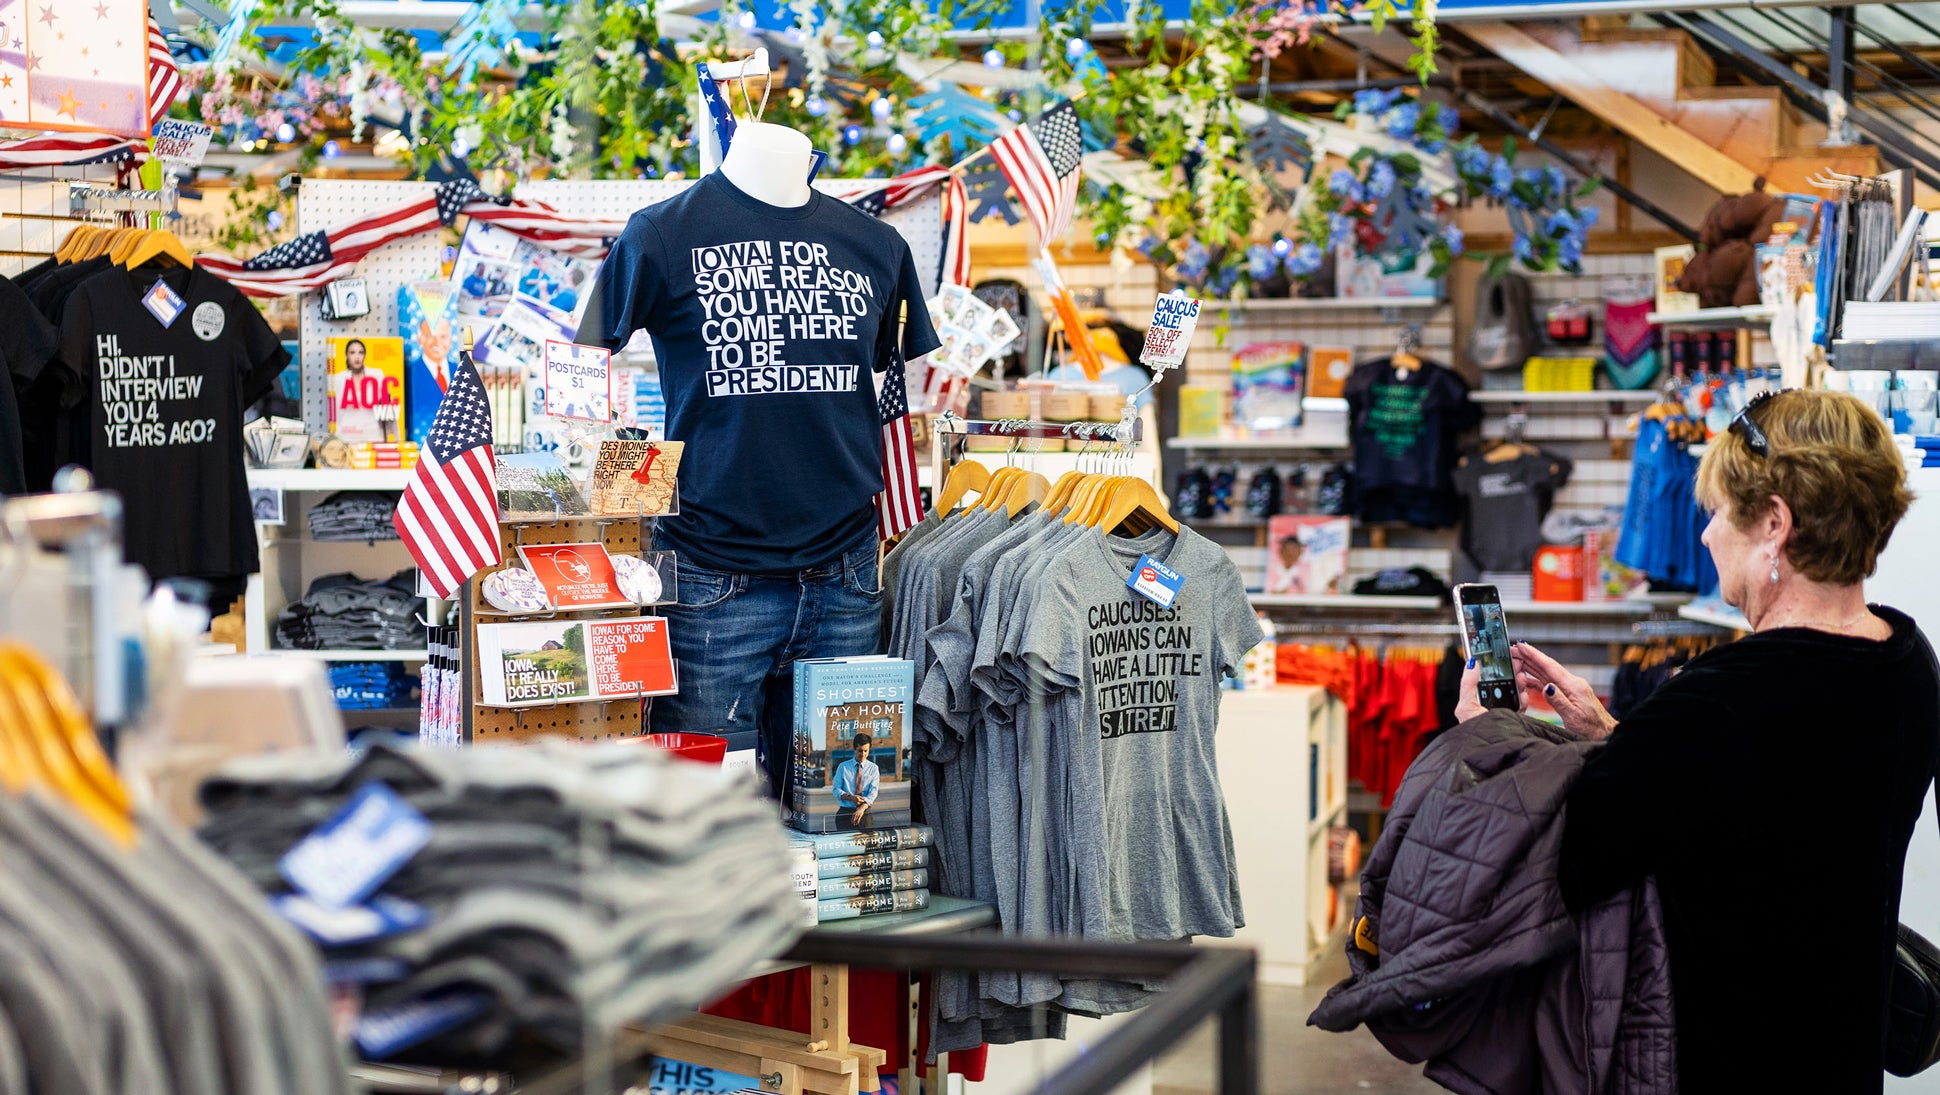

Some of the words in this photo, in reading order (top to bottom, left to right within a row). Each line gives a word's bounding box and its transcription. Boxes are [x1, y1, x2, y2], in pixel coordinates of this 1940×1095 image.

[162, 121, 211, 136] CAUCUS
[692, 240, 774, 274] IOWA!
[779, 241, 830, 267] FOR
[695, 265, 776, 295] SOME
[779, 265, 874, 298] REASON
[698, 291, 758, 320] YOU
[764, 290, 833, 314] HAVE
[835, 291, 868, 317] TO
[1157, 298, 1198, 317] CAUCUS
[1152, 312, 1182, 330] SALE!
[701, 315, 785, 345] COME
[789, 315, 858, 340] HERE
[1148, 326, 1166, 339] 50%
[1166, 329, 1183, 340] OFF
[96, 334, 122, 358] HI,
[1143, 345, 1168, 354] ITEMS!
[1145, 336, 1175, 349] SELECT
[706, 343, 744, 371] TO
[750, 340, 786, 367] BE
[98, 355, 165, 380] DIDN'T
[168, 354, 175, 378] I
[548, 361, 607, 379] POSTCARDS
[100, 375, 203, 402] INTERVIEW
[706, 365, 859, 397] PRESIDENT!
[340, 376, 400, 411] AOC
[103, 401, 144, 425] YOU
[145, 400, 160, 423] 4
[373, 404, 402, 422] WAY
[104, 422, 167, 448] YEARS
[168, 418, 217, 446] AGO?
[601, 441, 619, 451] DES
[620, 441, 657, 451] MOINES:
[599, 450, 616, 461] YOU
[617, 451, 647, 461] MIGHT
[596, 460, 606, 470] BE
[609, 460, 638, 470] THERE
[593, 470, 621, 480] RIGHT
[593, 480, 614, 490] NOW.
[1146, 557, 1180, 582] RAYGUN
[1088, 601, 1181, 630] CAUCUSES:
[592, 626, 615, 636] IOWA!
[616, 625, 632, 635] FOR
[633, 623, 656, 633] SOME
[593, 635, 628, 645] REASON,
[628, 634, 645, 643] YOU
[1089, 627, 1150, 659] IOWANS
[1154, 626, 1192, 650] CAN
[594, 645, 615, 655] HAVE
[615, 644, 627, 654] TO
[504, 659, 537, 673] IOWA:
[594, 654, 619, 665] COME
[596, 664, 619, 674] HERE
[1091, 656, 1128, 686] HAVE
[1129, 654, 1141, 678] A
[1145, 652, 1202, 677] LITTLE
[505, 673, 520, 686] IT
[520, 669, 559, 683] REALLY
[597, 674, 609, 684] TO
[610, 673, 622, 683] BE
[507, 685, 539, 699] DOES
[599, 681, 646, 693] PRESIDENT.
[816, 686, 908, 700] SHORTEST
[816, 706, 851, 718] WAY
[859, 703, 907, 716] HOME
[831, 720, 850, 731] Pete
[853, 719, 894, 732] Buttigieg
[1117, 712, 1125, 736] A
[849, 839, 867, 847] WAY
[870, 835, 897, 845] HOME
[843, 860, 862, 868] WAY
[865, 856, 892, 866] HOME
[842, 881, 862, 889] WAY
[865, 877, 891, 887] HOME
[844, 901, 863, 909] WAY
[866, 898, 893, 907] HOME
